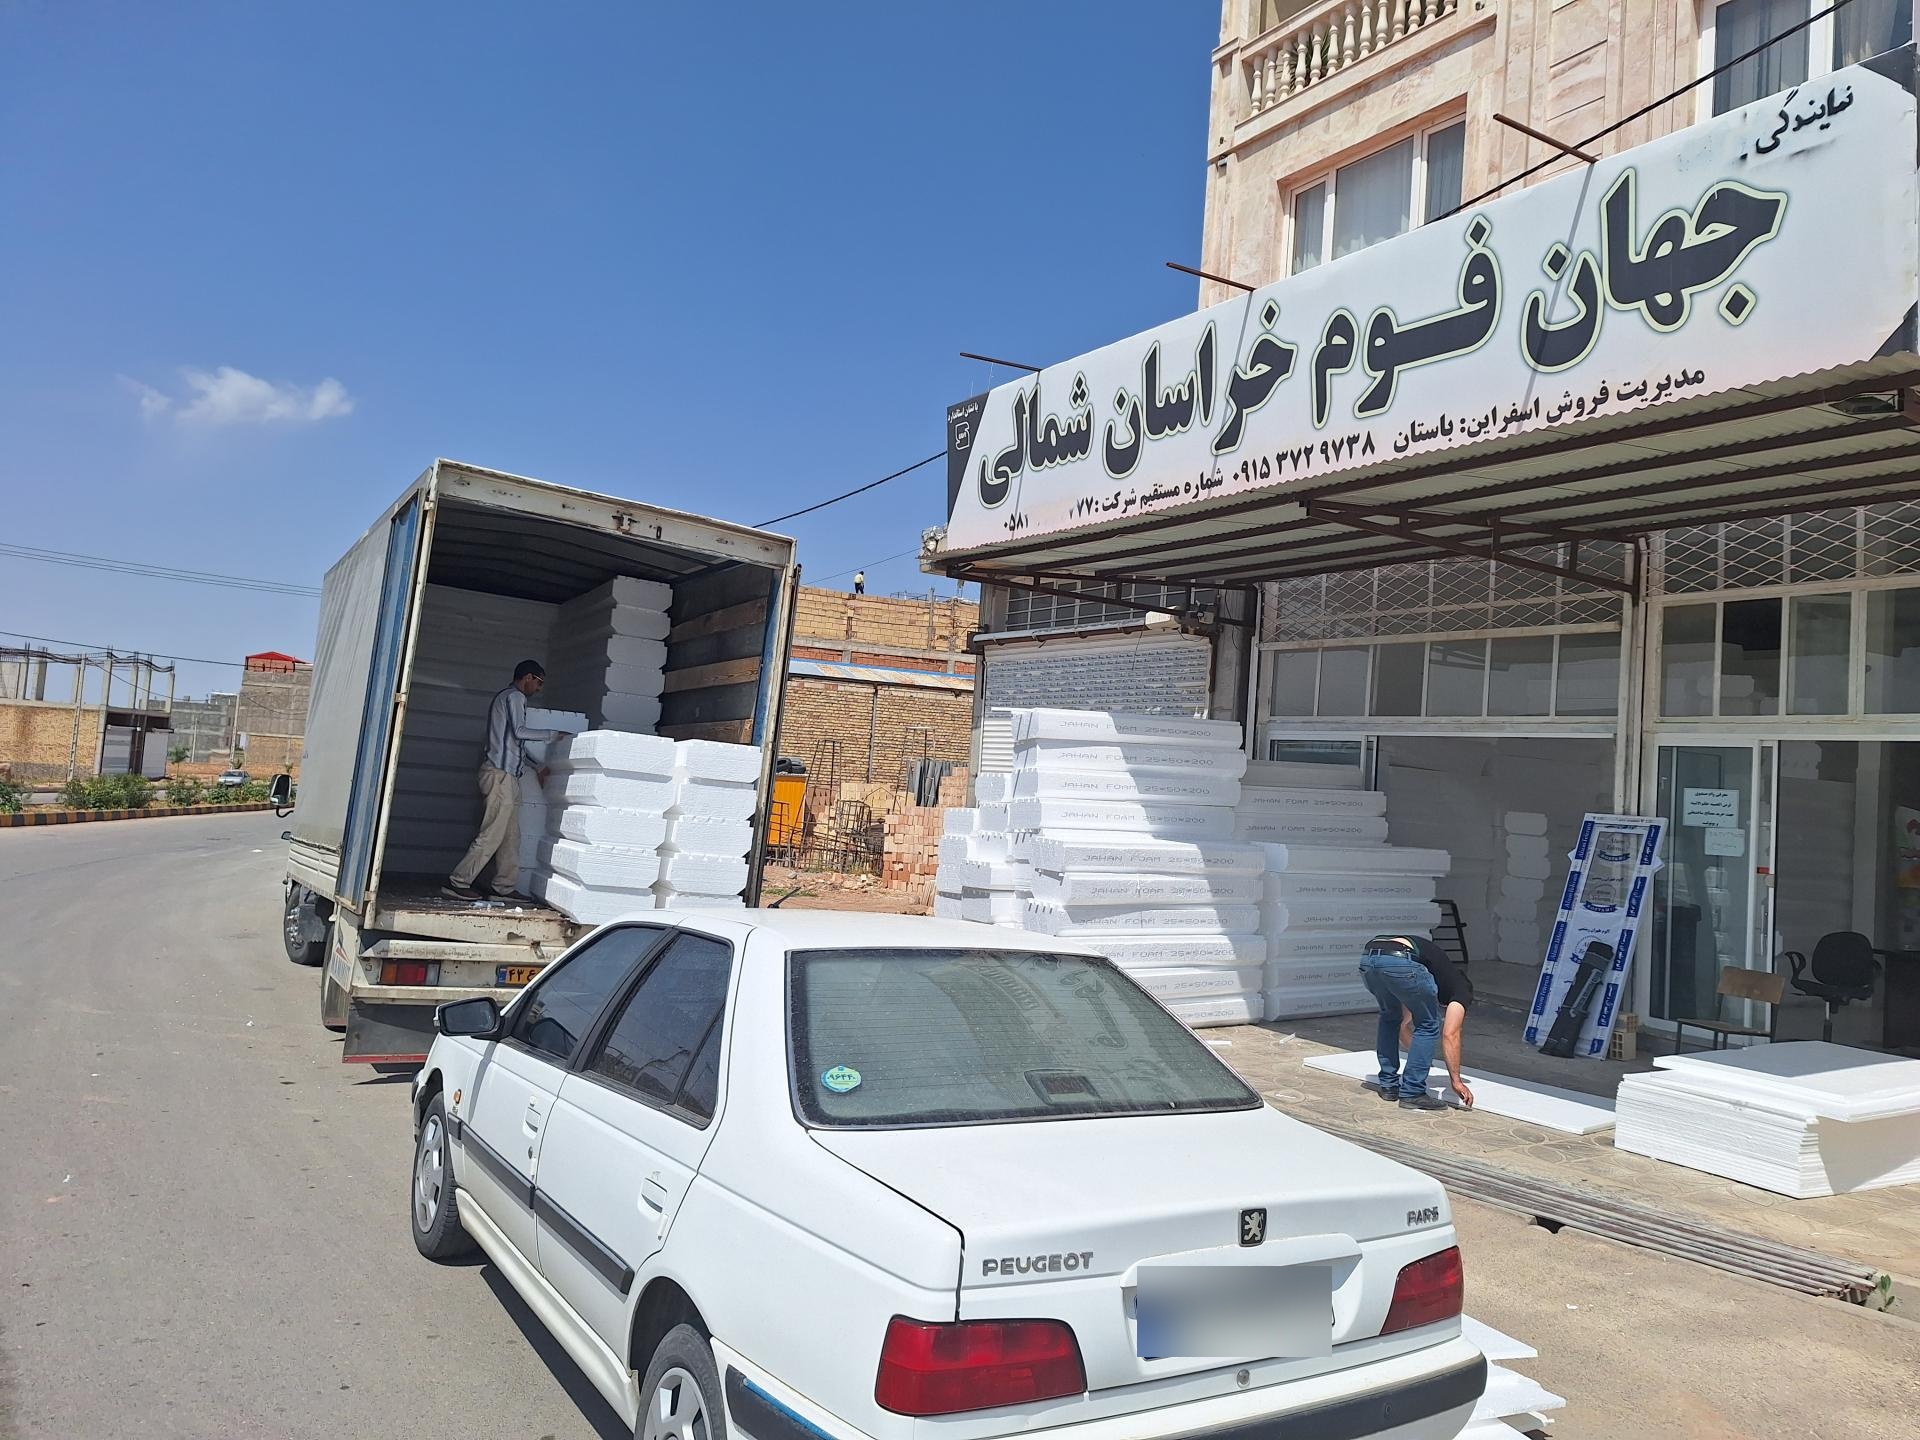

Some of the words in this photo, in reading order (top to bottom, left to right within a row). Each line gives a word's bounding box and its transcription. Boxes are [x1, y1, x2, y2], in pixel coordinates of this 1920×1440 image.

[1756, 85, 1854, 154] نمایندگی
[1519, 167, 1789, 374] جهان
[1310, 214, 1504, 428] فوم
[1102, 297, 1299, 480] خراسان
[1617, 367, 1705, 405] مدیریت
[1547, 379, 1610, 422] فروش
[1460, 397, 1540, 437] اسفراین:
[979, 371, 1094, 510] شمالی
[1393, 413, 1453, 453] باستان
[1275, 443, 1314, 475] ۳۷۲
[1319, 430, 1376, 465] ۹۷۳۸
[1183, 467, 1223, 498] شماره
[1232, 455, 1271, 483] ۰۹۱۵
[1139, 482, 1180, 510] مستقیم
[1060, 720, 1099, 729] JAHAN
[1107, 724, 1137, 733] FOAM
[1058, 752, 1098, 761] JAHAN
[1106, 754, 1137, 762] FOAM
[1062, 782, 1099, 790] JAHAN
[1106, 783, 1136, 791] FOAM
[1252, 797, 1281, 805] JAHAN
[1060, 811, 1099, 819] JAHAN
[1106, 813, 1135, 821] FOAM
[1281, 825, 1306, 833] FOAM
[1083, 854, 1123, 863] JAHAN
[1130, 855, 1161, 863] FOAM
[1090, 886, 1128, 895] JAHAN
[1124, 917, 1156, 925] FOAM
[1131, 951, 1163, 959] FOAM
[1146, 983, 1167, 991] OAM
[1406, 1206, 1439, 1227] PARS
[982, 1251, 1094, 1277] PEUGEOT
